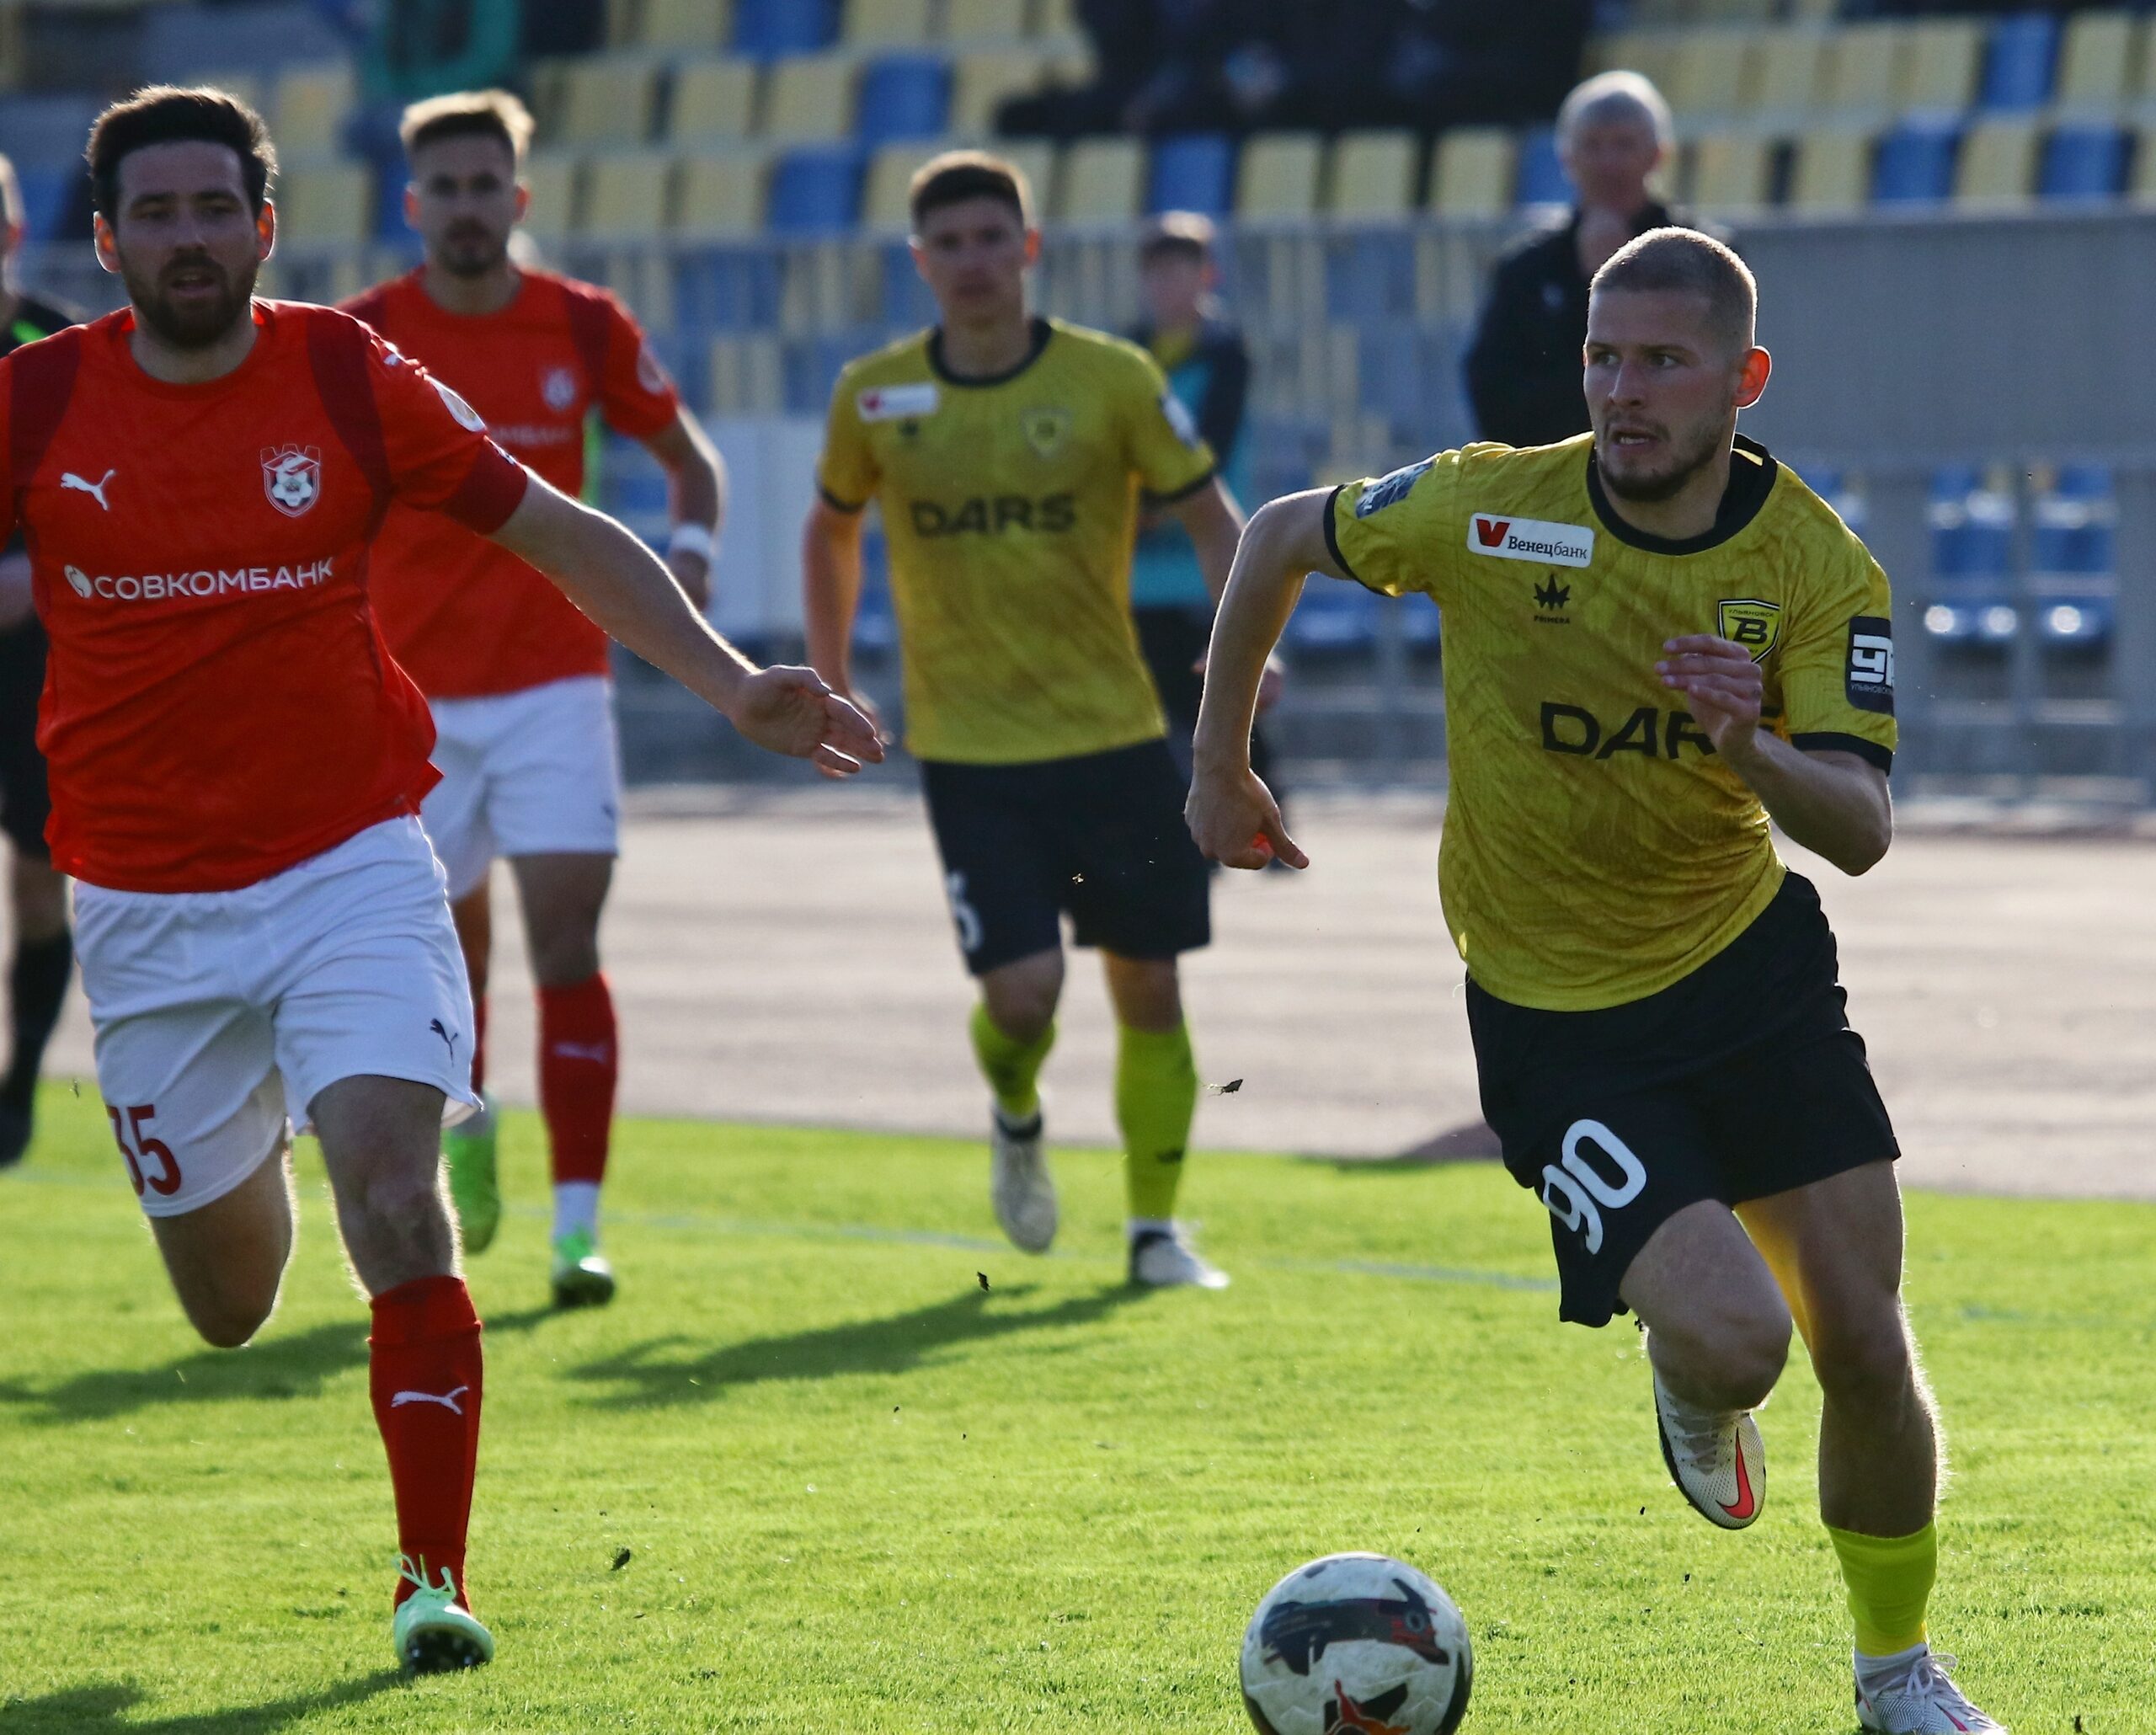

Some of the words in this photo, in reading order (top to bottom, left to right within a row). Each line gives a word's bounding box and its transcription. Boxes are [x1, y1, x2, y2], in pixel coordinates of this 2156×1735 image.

[910, 493, 1076, 538] DARS
[1508, 536, 1588, 559] Венецбанк
[94, 557, 334, 600] СОВКОМБАНК
[1542, 1118, 1647, 1255] 90
